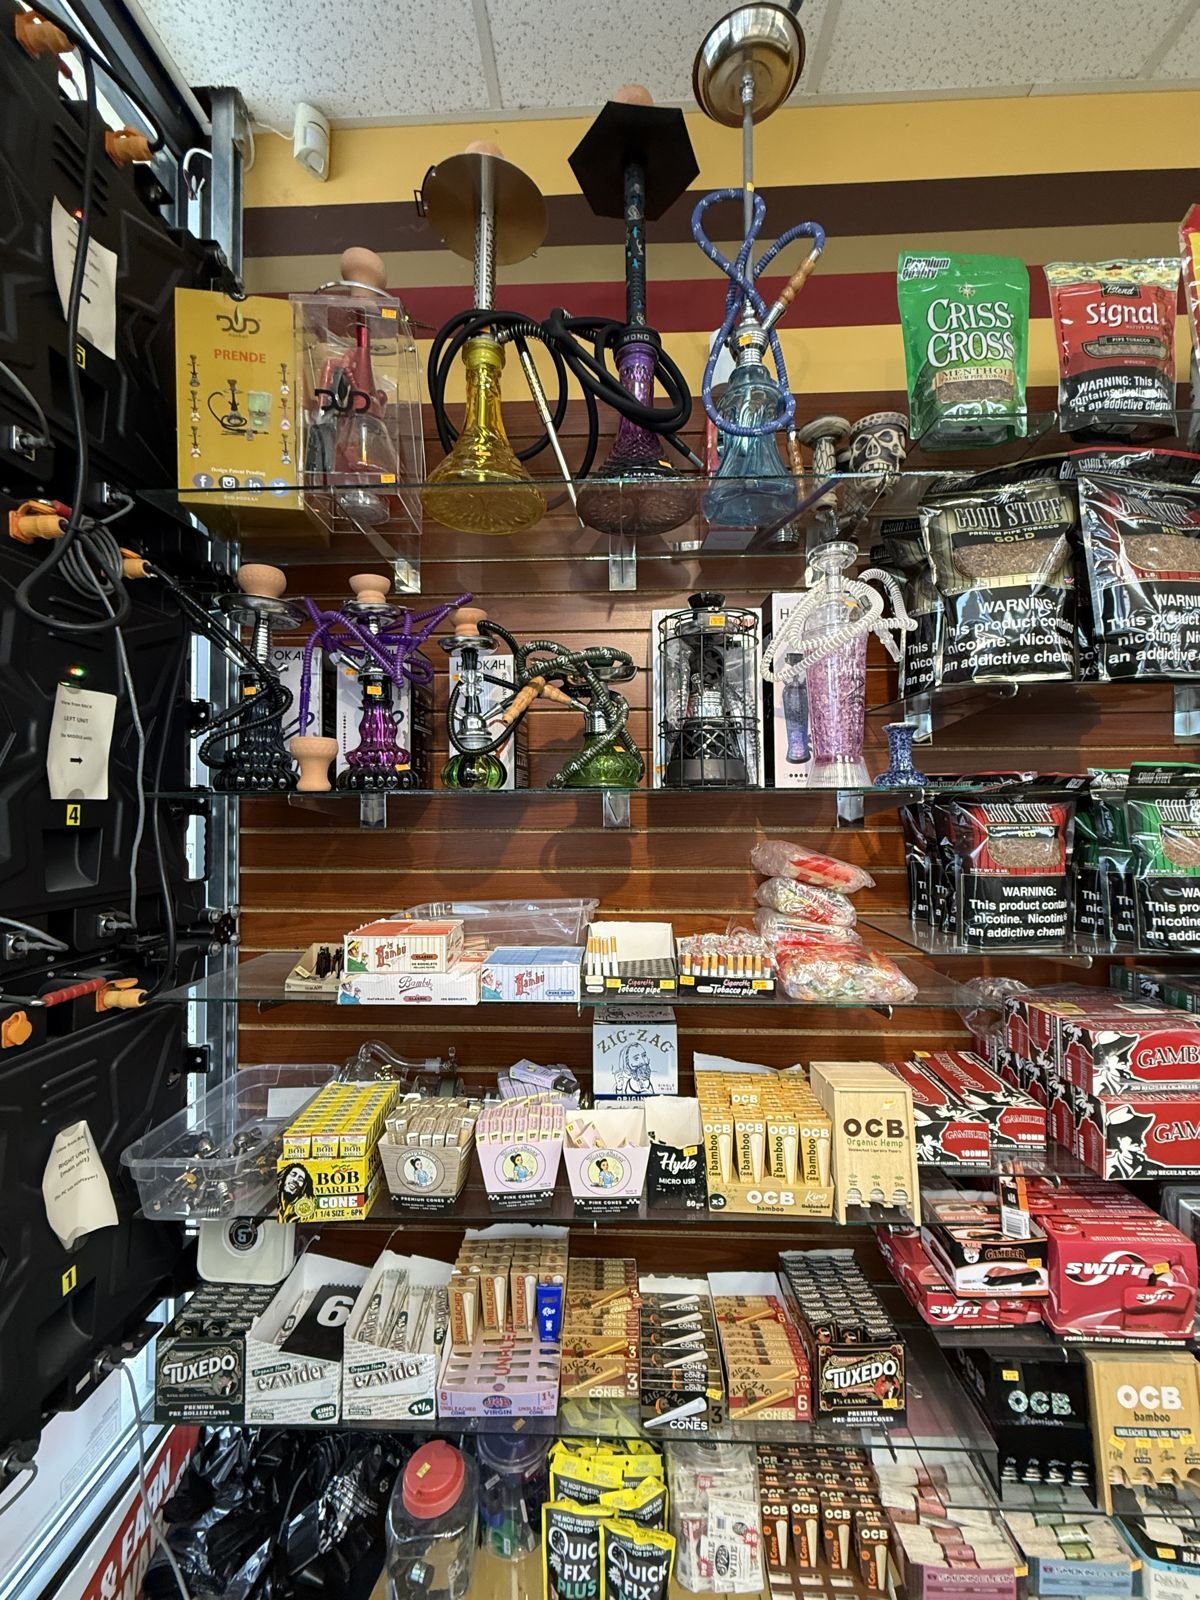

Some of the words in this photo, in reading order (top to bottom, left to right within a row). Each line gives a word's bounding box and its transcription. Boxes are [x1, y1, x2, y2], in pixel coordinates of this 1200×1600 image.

[904, 257, 950, 269] Premium
[1086, 302, 1160, 327] Signal
[624, 334, 650, 342] MONO
[927, 331, 1015, 367] CROSS
[213, 348, 267, 364] PRENDE
[1077, 375, 1132, 394] WARNING:
[1134, 376, 1153, 387] This
[954, 506, 1001, 528] GOOD
[1005, 499, 1062, 527] STUFF
[1003, 528, 1021, 536] PIPE
[1022, 523, 1059, 533] TOBACCO
[994, 532, 1035, 543] GOLD
[979, 597, 1058, 614] WARNING:
[1107, 614, 1147, 630] This
[908, 643, 928, 656] This
[1108, 651, 1131, 664] an
[1135, 647, 1196, 661] addictive
[69, 806, 79, 824] 4
[981, 803, 1017, 822] GOOD
[1014, 803, 1054, 822] STUFF
[1155, 798, 1190, 822] GOOD
[1002, 886, 1058, 898] WARNING:
[969, 898, 997, 910] This
[999, 899, 1040, 912] product
[968, 926, 985, 937] an
[987, 926, 1036, 938] addictive
[525, 970, 532, 979] is
[628, 977, 655, 987] Cigarette
[618, 983, 645, 994] Tobacco
[646, 986, 662, 996] pipe
[713, 983, 741, 994] Tobacco
[741, 986, 758, 997] pipe
[597, 1029, 675, 1055] ZIG-ZAG
[732, 1094, 758, 1103] OCB
[1002, 1114, 1046, 1125] GAMBLER
[704, 1124, 731, 1133] OCB
[736, 1122, 764, 1133] OCB
[769, 1126, 797, 1135] OCB
[801, 1128, 830, 1138] OCB
[843, 1118, 905, 1139] OCB
[945, 1130, 989, 1140] GAMBLER
[1018, 1133, 1046, 1141] 100MM
[846, 1138, 878, 1149] Organic
[880, 1138, 905, 1149] Hemp
[288, 1147, 305, 1155] BOB
[709, 1134, 718, 1170] bamboo
[741, 1133, 750, 1171] bamboo
[774, 1136, 783, 1174] bamboo
[807, 1138, 816, 1176] bamboo
[961, 1150, 988, 1158] 100MM
[59, 1156, 74, 1170] RIGHT
[76, 1148, 90, 1159] UNIT
[657, 1151, 698, 1174] Hyde
[316, 1170, 360, 1186] BOB
[658, 1177, 682, 1186] MICRO
[315, 1186, 361, 1195] MARLEY
[804, 1190, 829, 1203] King
[319, 1195, 358, 1209] CONE
[711, 1197, 725, 1206] x3
[747, 1190, 795, 1206] OCB
[320, 1209, 330, 1218] 1/4
[331, 1209, 345, 1217] SIZE
[350, 1208, 364, 1217] 6PK
[985, 1248, 1026, 1260] GAMBLER
[1065, 1262, 1147, 1276] SWIFT
[64, 1271, 74, 1289] 1
[630, 1288, 639, 1298] 3
[1136, 1292, 1175, 1302] SWIFT
[517, 1275, 525, 1325] UNBLEACHED
[316, 1295, 355, 1328] 6
[455, 1292, 463, 1340] UNBLEACHED
[929, 1305, 982, 1315] SWIFT
[777, 1312, 786, 1322] 6
[564, 1336, 593, 1348] ZIG-ZAG
[628, 1345, 637, 1358] 3
[163, 1355, 236, 1384] TUXEDO
[562, 1359, 604, 1375] ZIG-ZAG
[731, 1367, 762, 1379] ZIG-ZAG
[825, 1360, 897, 1389] TUXEDO
[627, 1374, 638, 1390] 3
[440, 1391, 448, 1400] 6
[588, 1388, 625, 1397] CONES
[730, 1383, 773, 1397] ZIG-ZAG
[797, 1395, 808, 1411] 6
[1007, 1390, 1072, 1415] OCB
[1117, 1384, 1183, 1410] OCB
[168, 1410, 209, 1418] PRE-ROLLED
[710, 1405, 723, 1424] 3
[757, 1410, 796, 1421] CONES
[1134, 1411, 1171, 1422] bamboo
[670, 1420, 708, 1430] CONES
[121, 1448, 172, 1578] EARN
[762, 1504, 788, 1515] OCB
[792, 1503, 818, 1514] OCB
[825, 1508, 850, 1520] OCB
[562, 1514, 575, 1522] MOST
[576, 1517, 595, 1526] TRUSTED
[861, 1528, 888, 1540] OCB
[730, 1545, 738, 1579] WIDE
[564, 1564, 591, 1582] FIX
[557, 1576, 597, 1600] PLUS
[624, 1579, 652, 1600] FIX
